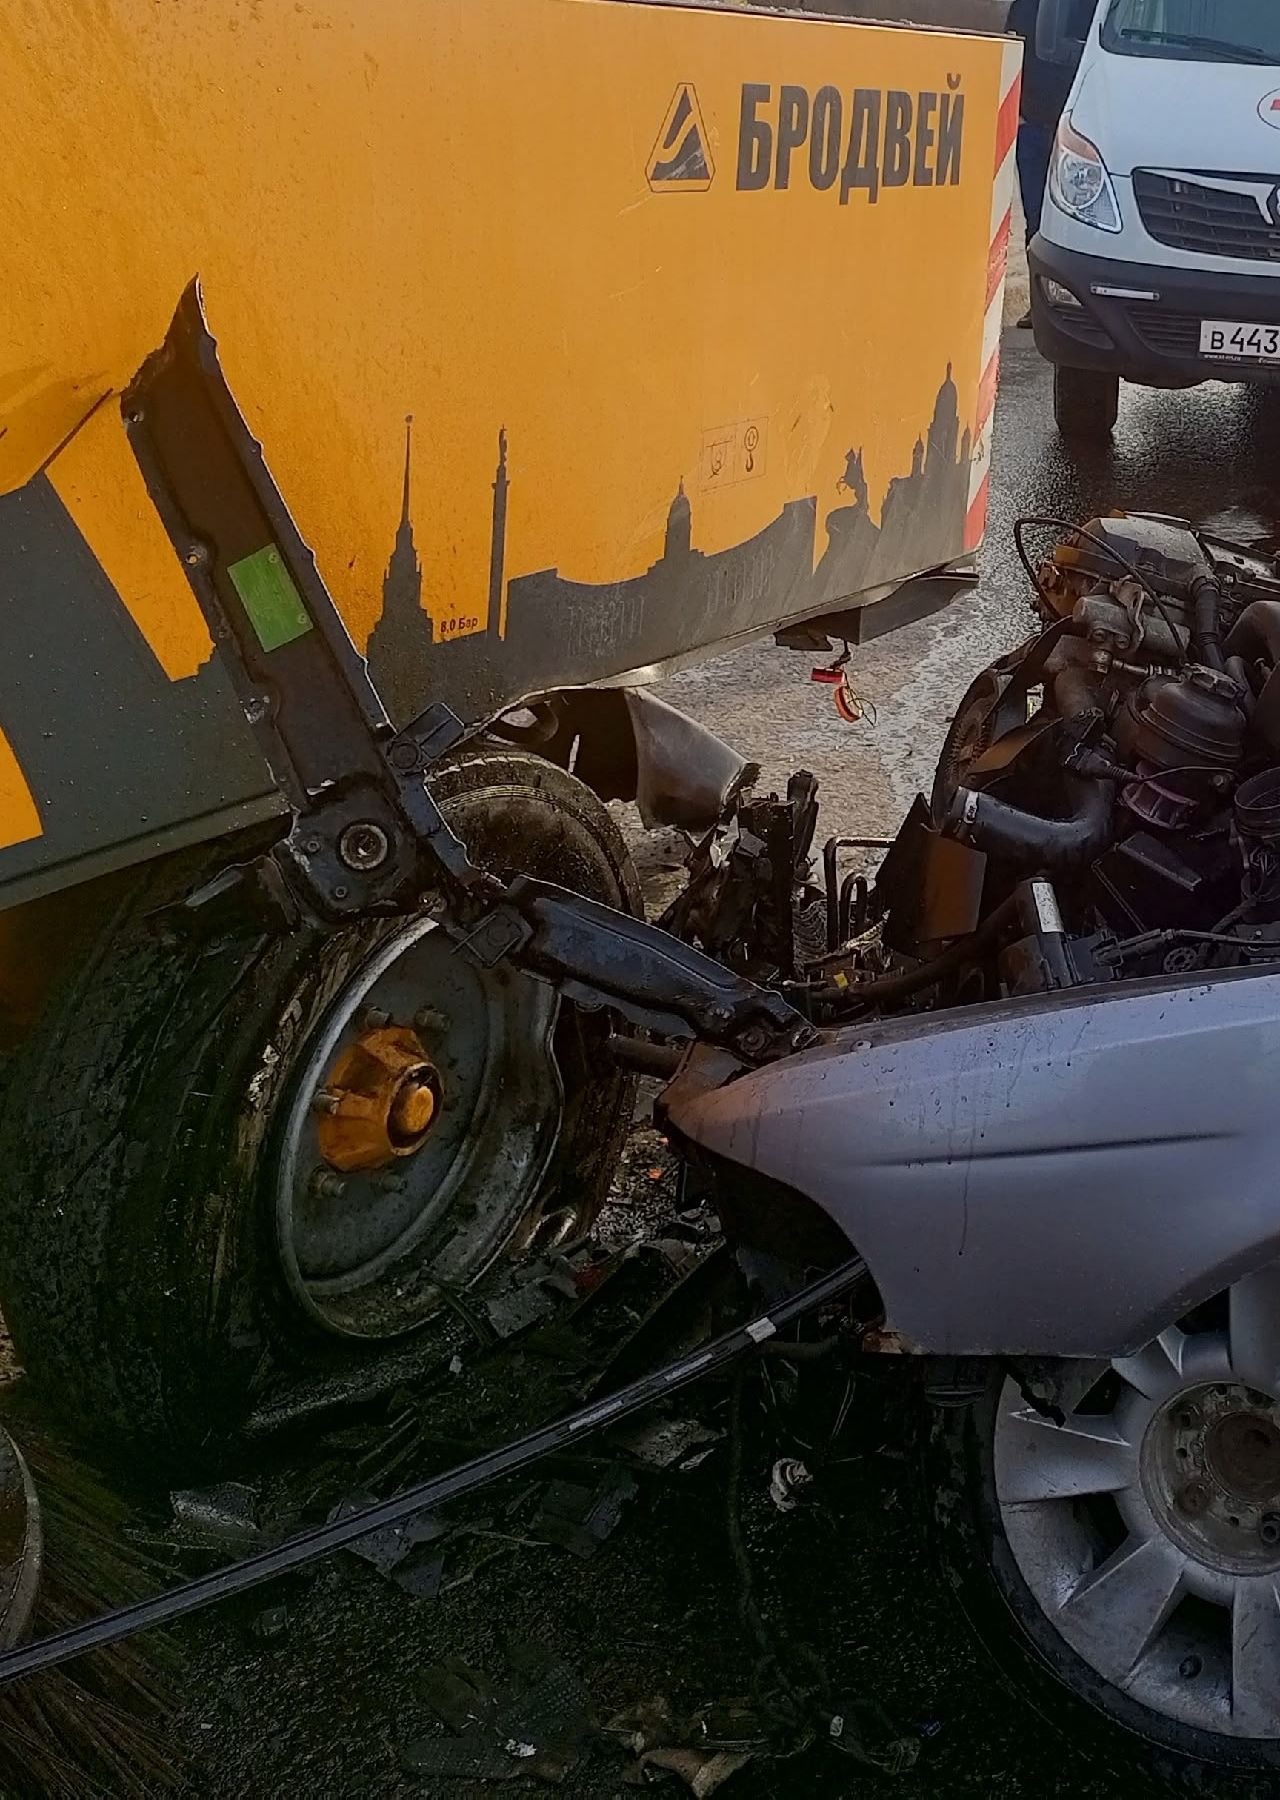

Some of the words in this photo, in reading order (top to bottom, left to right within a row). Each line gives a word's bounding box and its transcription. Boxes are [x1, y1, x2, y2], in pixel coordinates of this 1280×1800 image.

[736, 73, 965, 205] БРОДВЕЙ
[440, 618, 456, 633] 8,0
[459, 617, 478, 630] Бар
